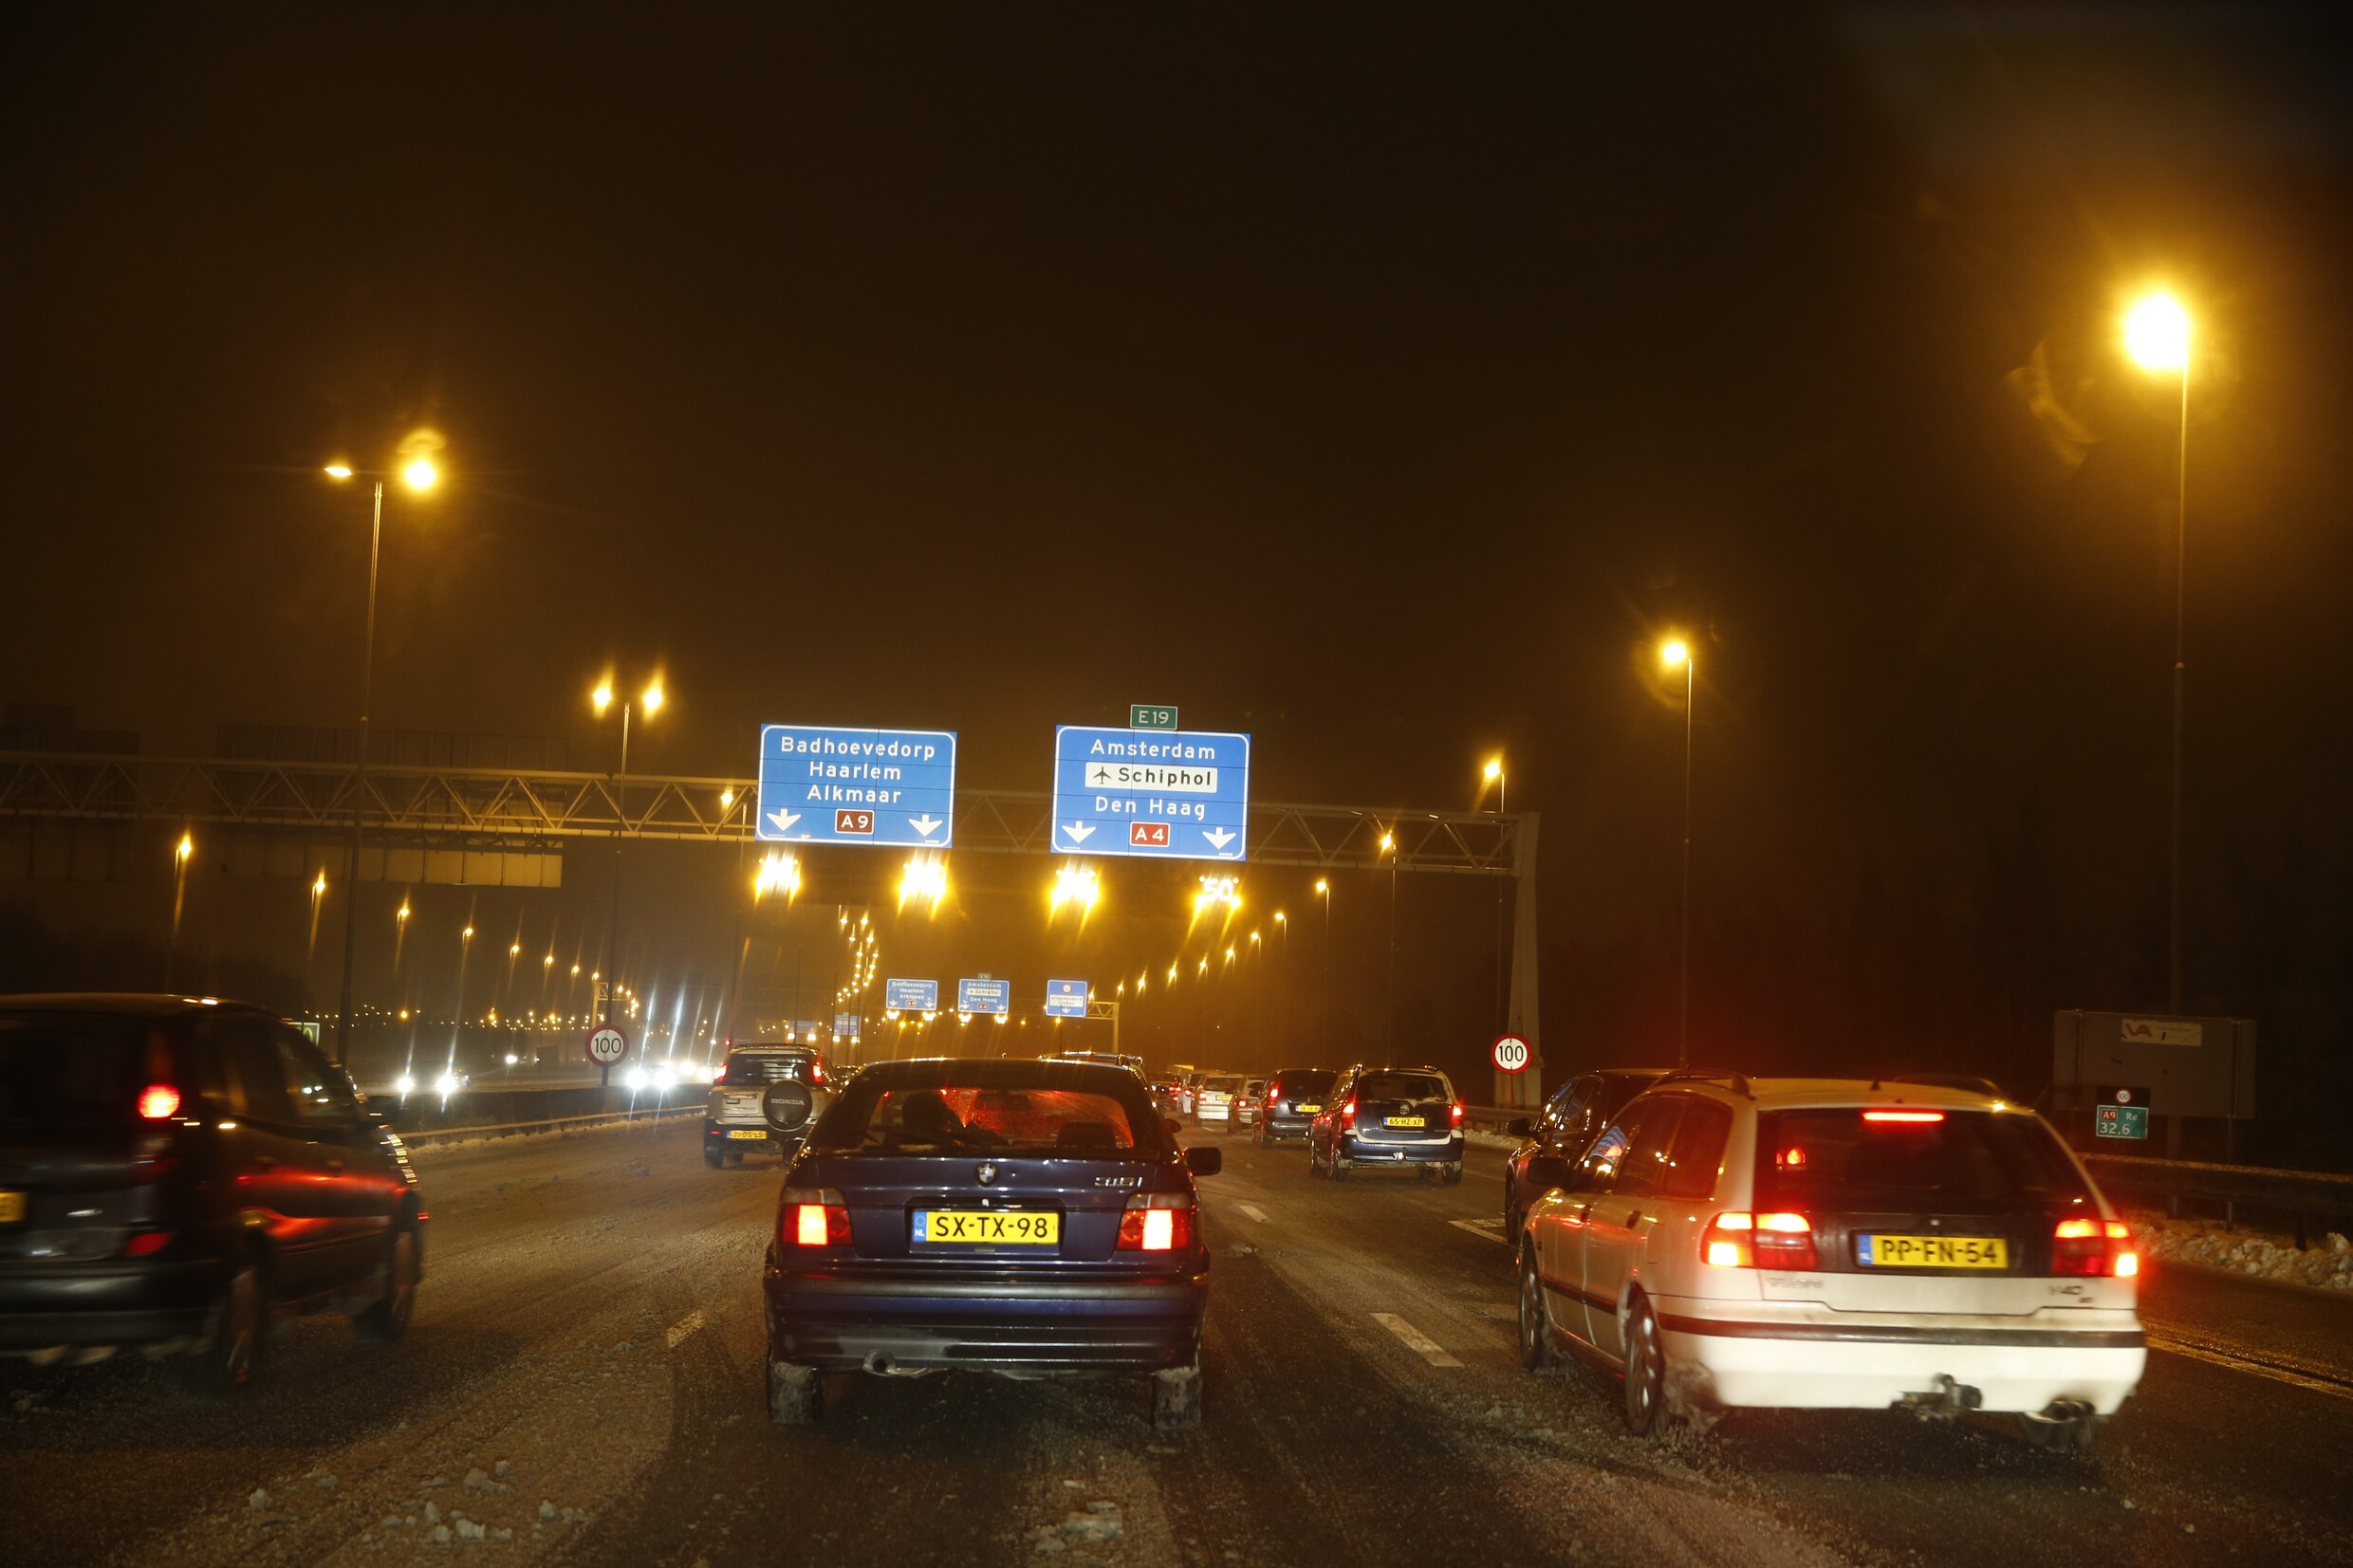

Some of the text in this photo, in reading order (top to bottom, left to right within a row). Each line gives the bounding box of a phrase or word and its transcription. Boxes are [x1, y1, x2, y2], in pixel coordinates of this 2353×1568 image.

[781, 736, 936, 761] Badhoevedorp
[1090, 739, 1215, 760] Amsterdam
[809, 761, 901, 781] Haarlem
[1118, 767, 1212, 786] Schiphol
[806, 784, 902, 803] Alkmaar
[1095, 796, 1206, 821] Den Haag
[841, 814, 869, 829] A9
[1134, 827, 1164, 841] A4
[1203, 878, 1233, 901] 50
[594, 1037, 622, 1054] 100
[1498, 1045, 1525, 1062] 100
[770, 1098, 806, 1106] HONDA
[2103, 1111, 2116, 1119] A9
[2125, 1112, 2138, 1120] Re
[2100, 1122, 2131, 1135] 32,6
[936, 1216, 1047, 1238] SX-TX-98
[1881, 1239, 1998, 1264] PP-FN-54
